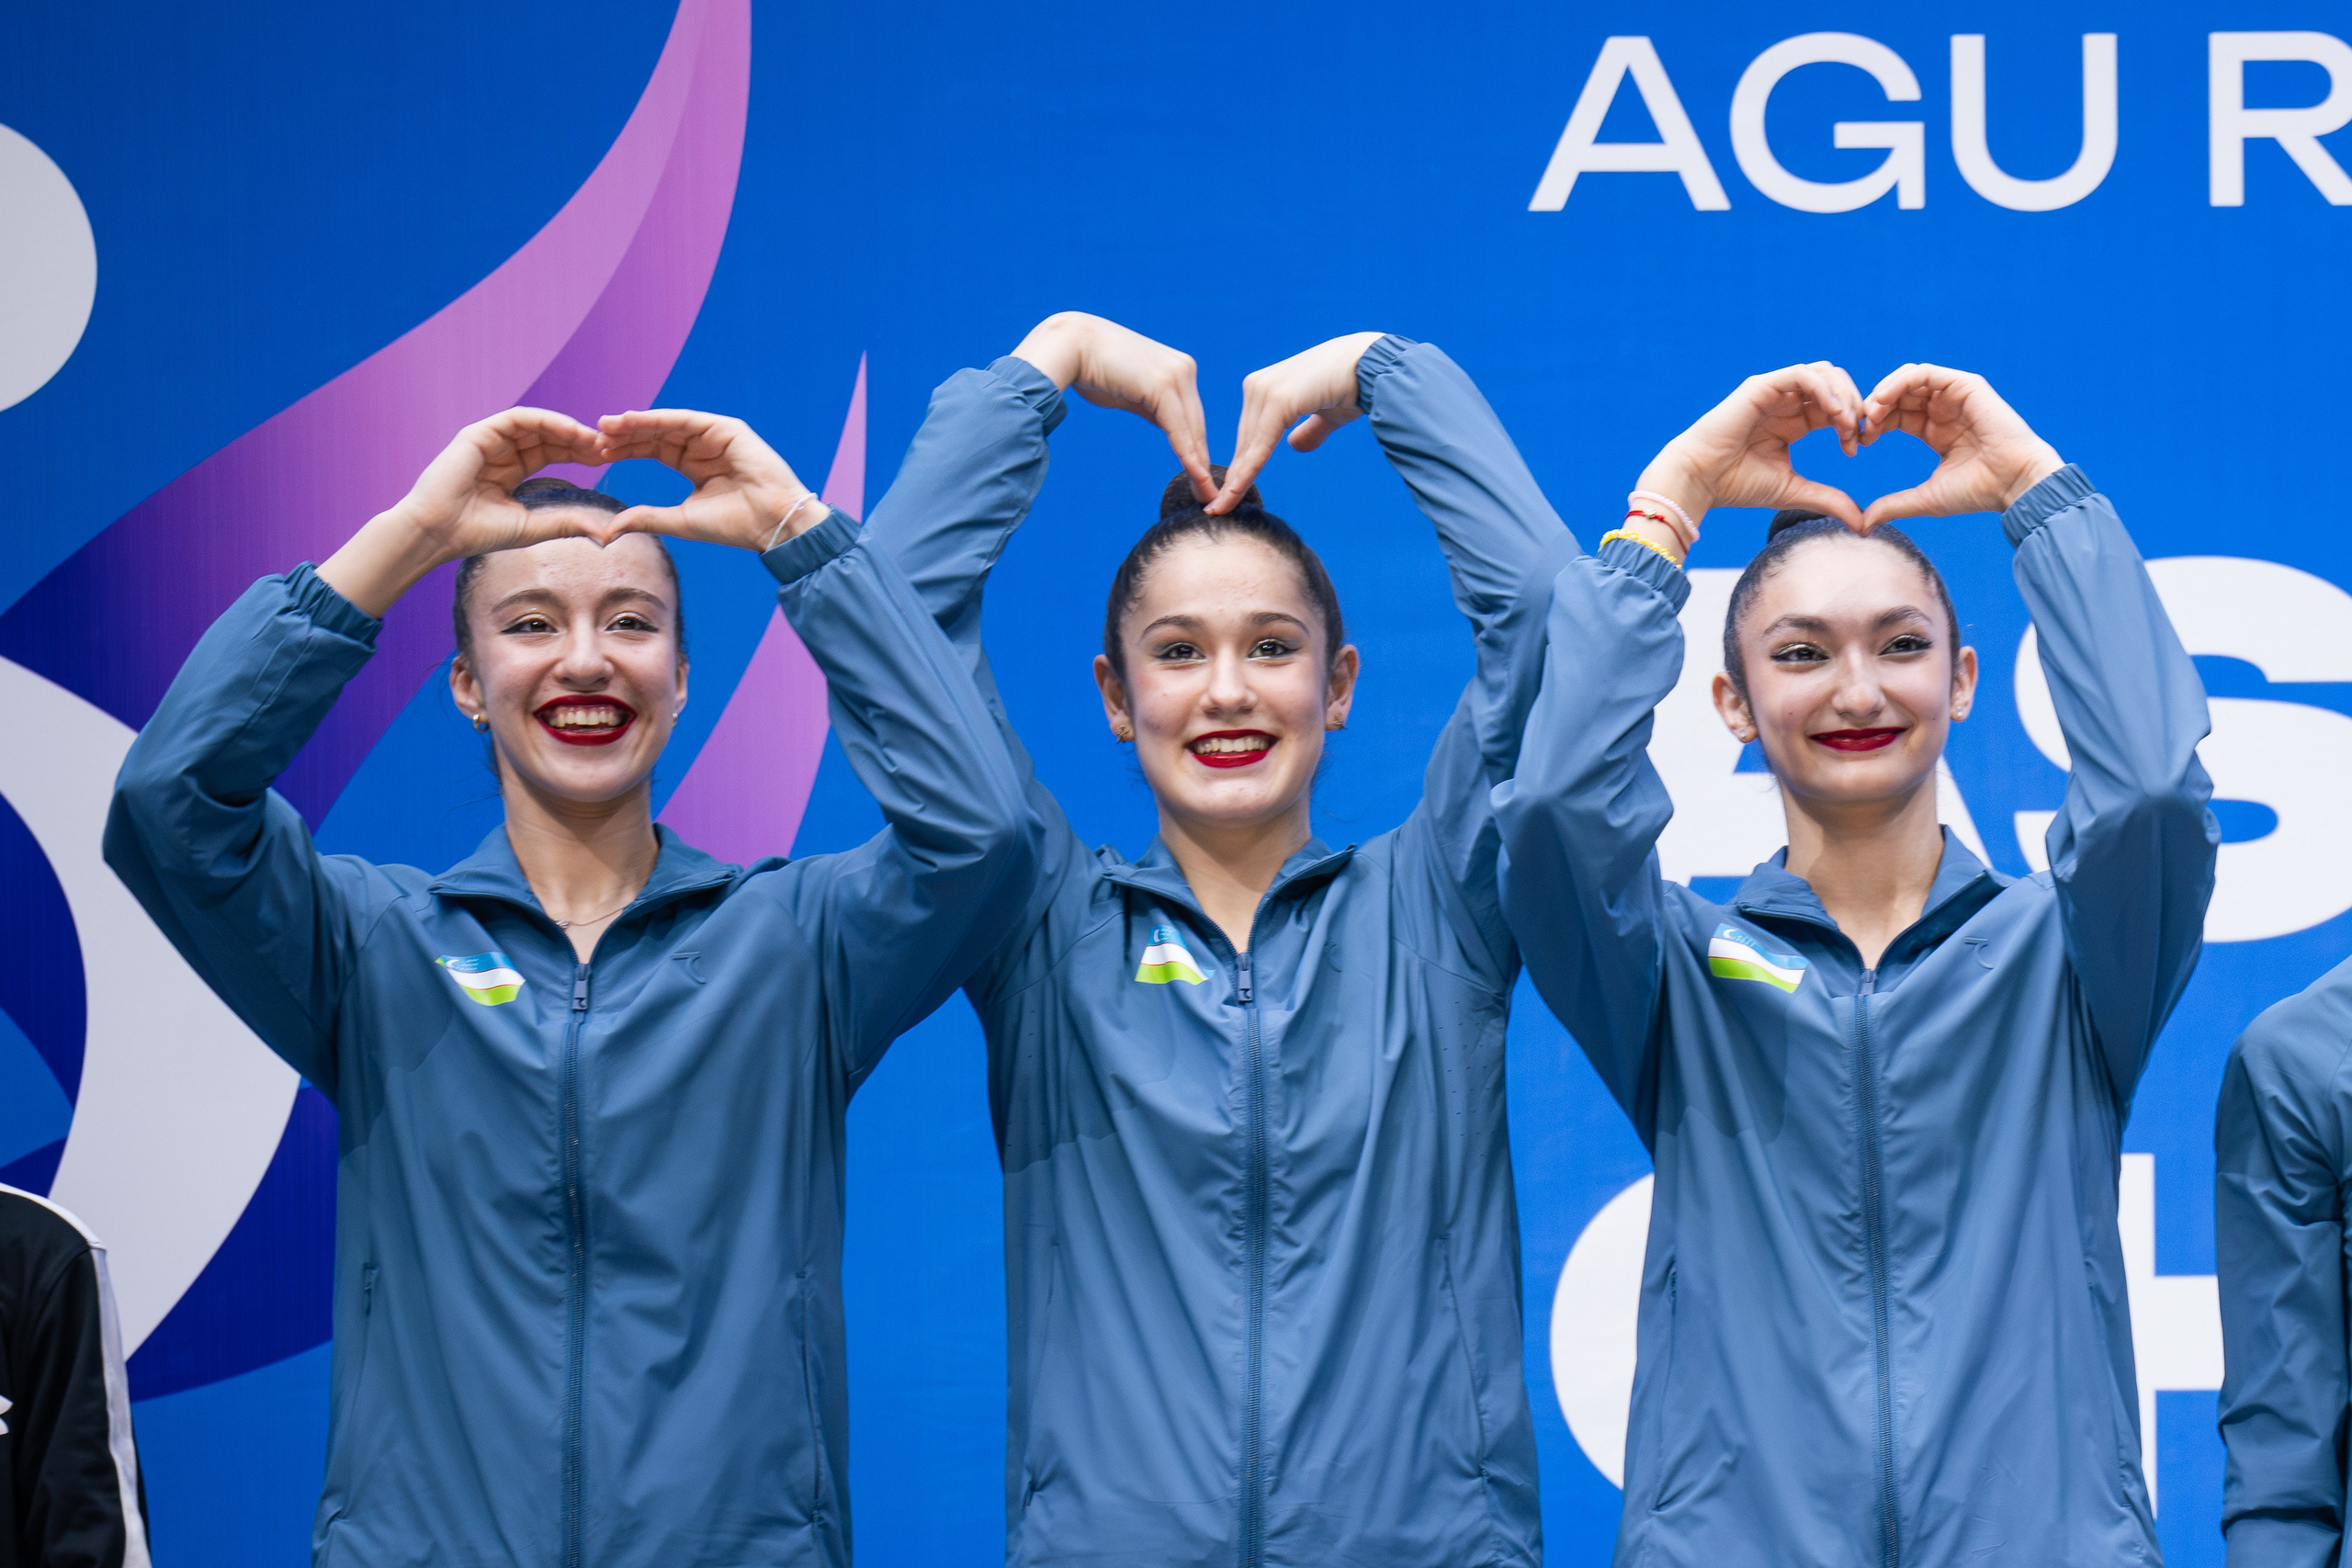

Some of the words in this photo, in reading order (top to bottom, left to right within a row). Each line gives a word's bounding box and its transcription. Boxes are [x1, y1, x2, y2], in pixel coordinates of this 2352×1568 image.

[1528, 31, 2119, 214] AGU
[2208, 30, 2352, 208] R
[1645, 556, 2352, 943] S
